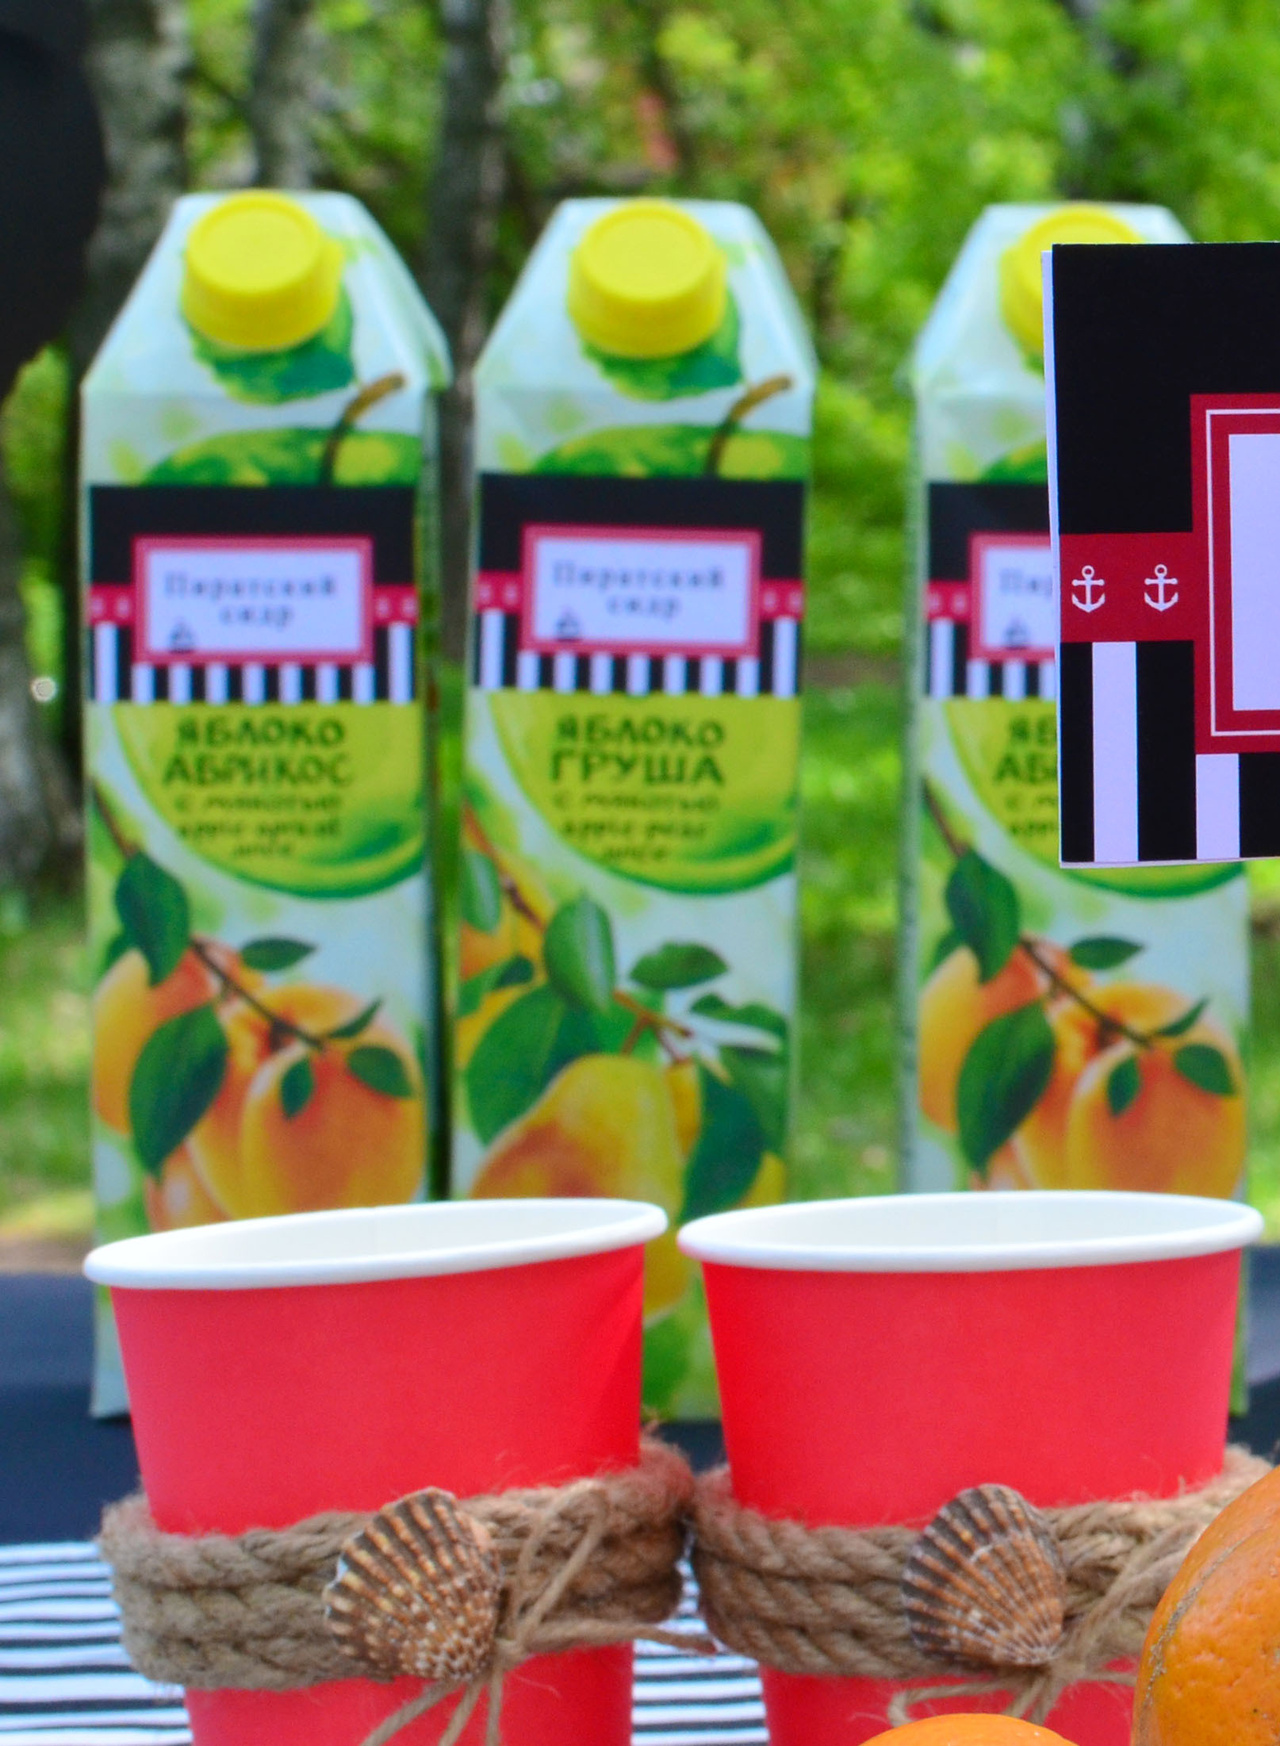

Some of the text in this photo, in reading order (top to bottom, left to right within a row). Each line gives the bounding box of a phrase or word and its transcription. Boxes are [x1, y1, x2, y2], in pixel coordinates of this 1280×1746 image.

[177, 716, 346, 747] ЯБЛОКО
[556, 714, 725, 747] ЯБЛОКО
[161, 752, 353, 787] АБРИКОС
[550, 749, 725, 787] ГРУША
